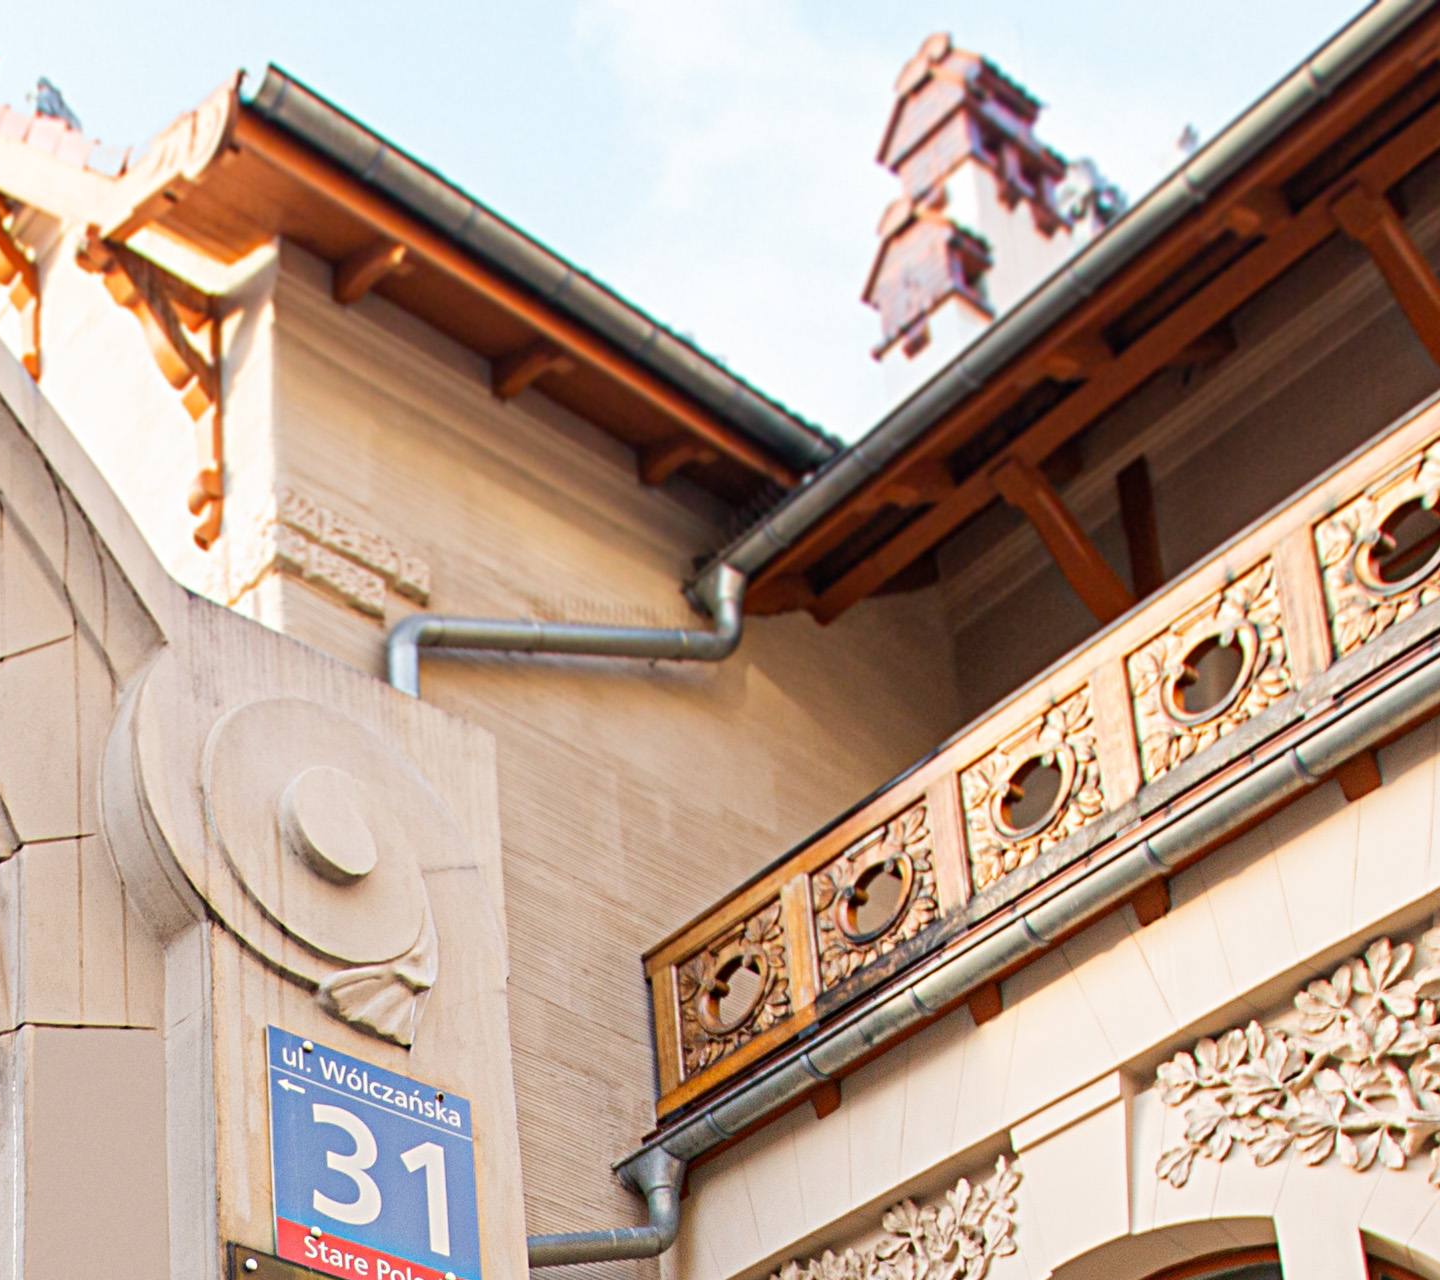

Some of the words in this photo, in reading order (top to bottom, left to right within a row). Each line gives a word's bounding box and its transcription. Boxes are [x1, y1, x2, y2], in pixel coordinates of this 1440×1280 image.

[281, 1046, 312, 1073] ul.
[319, 1057, 462, 1128] Wólczańska
[312, 1102, 451, 1257] 31
[303, 1235, 369, 1276] Stare
